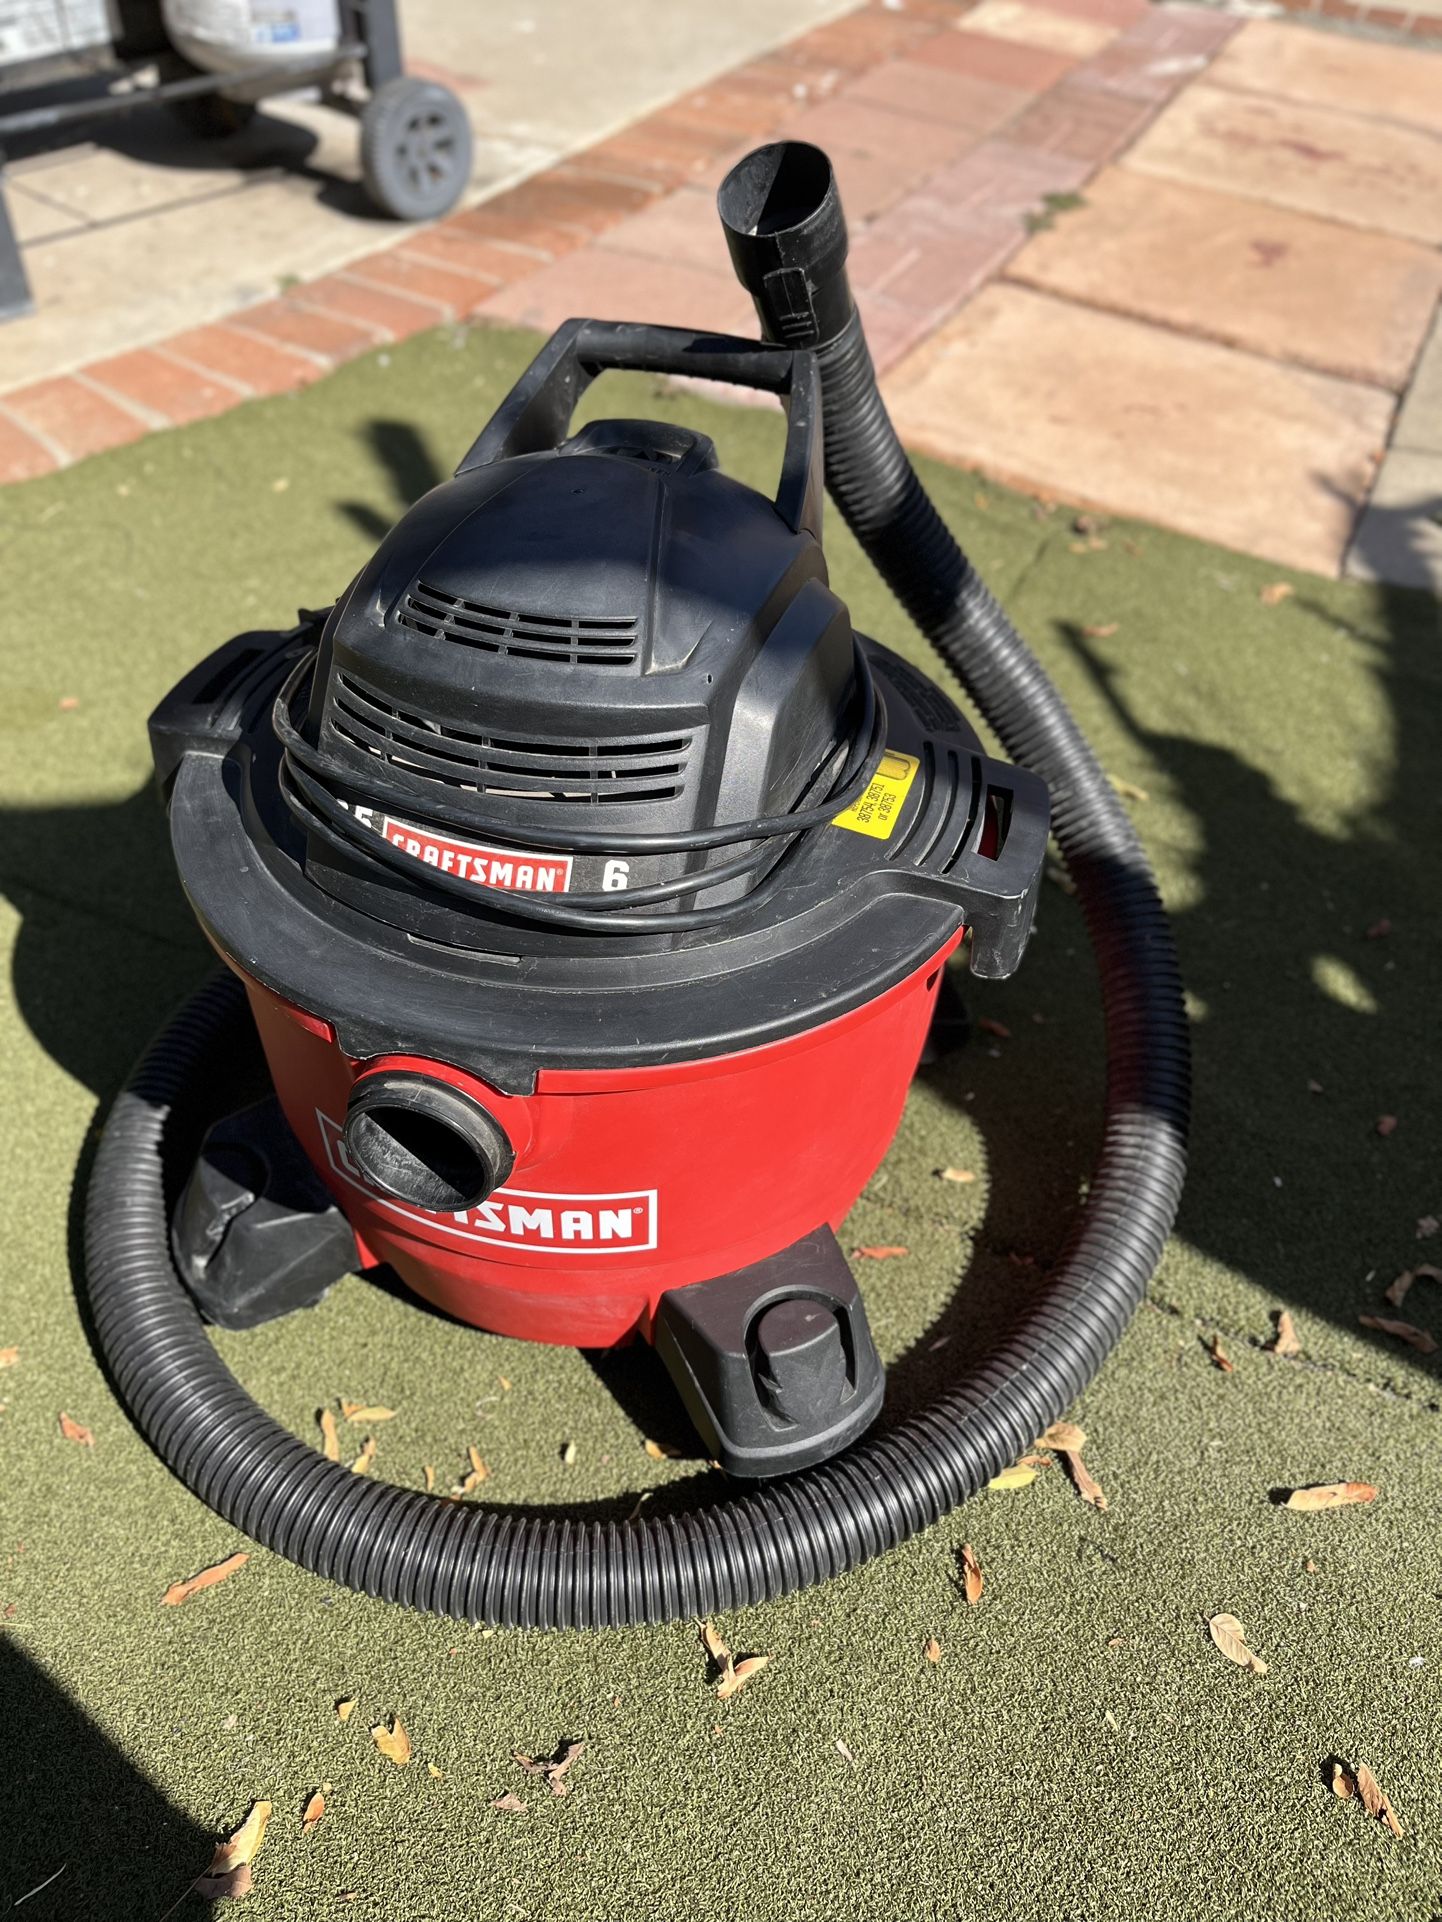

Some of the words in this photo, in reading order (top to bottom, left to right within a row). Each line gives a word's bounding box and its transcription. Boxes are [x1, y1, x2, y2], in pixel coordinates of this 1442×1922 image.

[878, 792, 897, 814] 38753
[878, 812, 889, 821] or
[602, 859, 630, 892] 6
